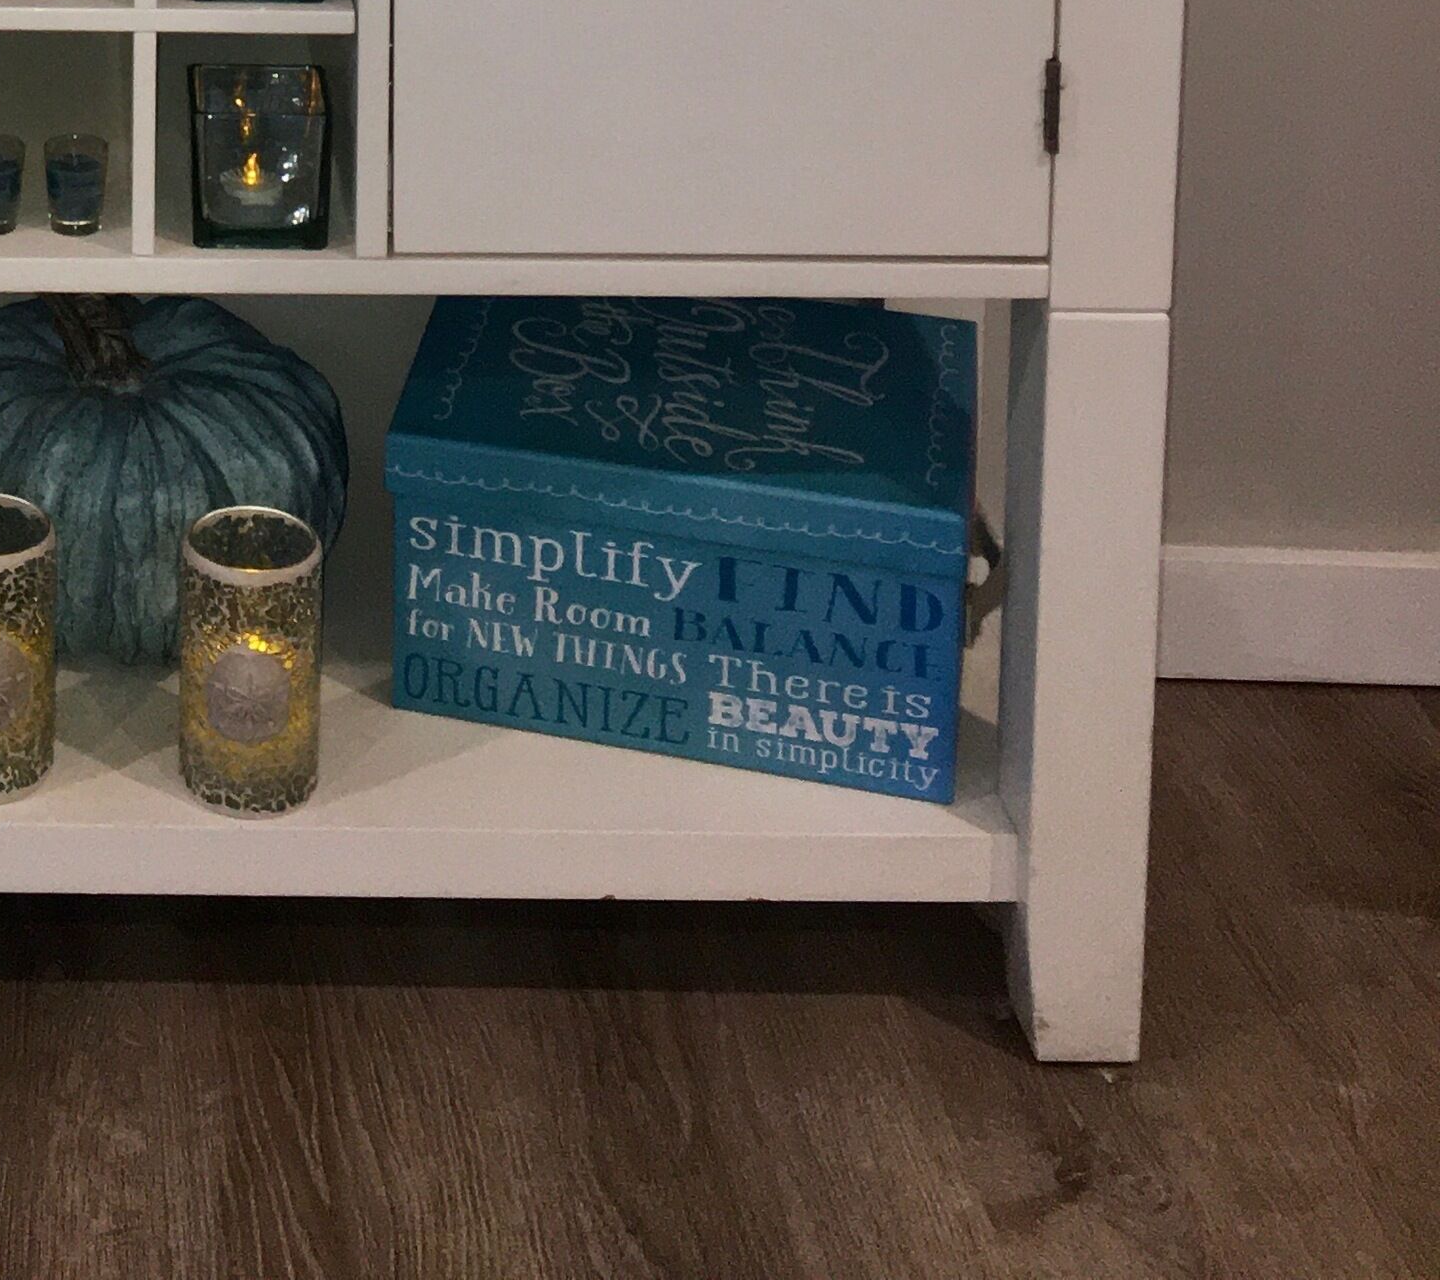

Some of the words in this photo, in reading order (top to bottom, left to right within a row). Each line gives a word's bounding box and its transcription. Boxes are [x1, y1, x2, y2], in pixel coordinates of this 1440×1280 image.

[409, 514, 704, 602] simplify
[718, 555, 946, 632] FIND
[406, 562, 517, 616] Make
[533, 585, 651, 639] Room
[406, 607, 455, 641] for
[466, 616, 539, 658] NEW
[552, 630, 689, 686] THINGS
[673, 606, 943, 682] BALANCE
[403, 652, 692, 745] ORGANIZE
[707, 653, 869, 710] There
[880, 684, 933, 719] is
[706, 725, 741, 754] in
[755, 736, 940, 792] simplicity
[707, 690, 940, 761] BEAUTY
